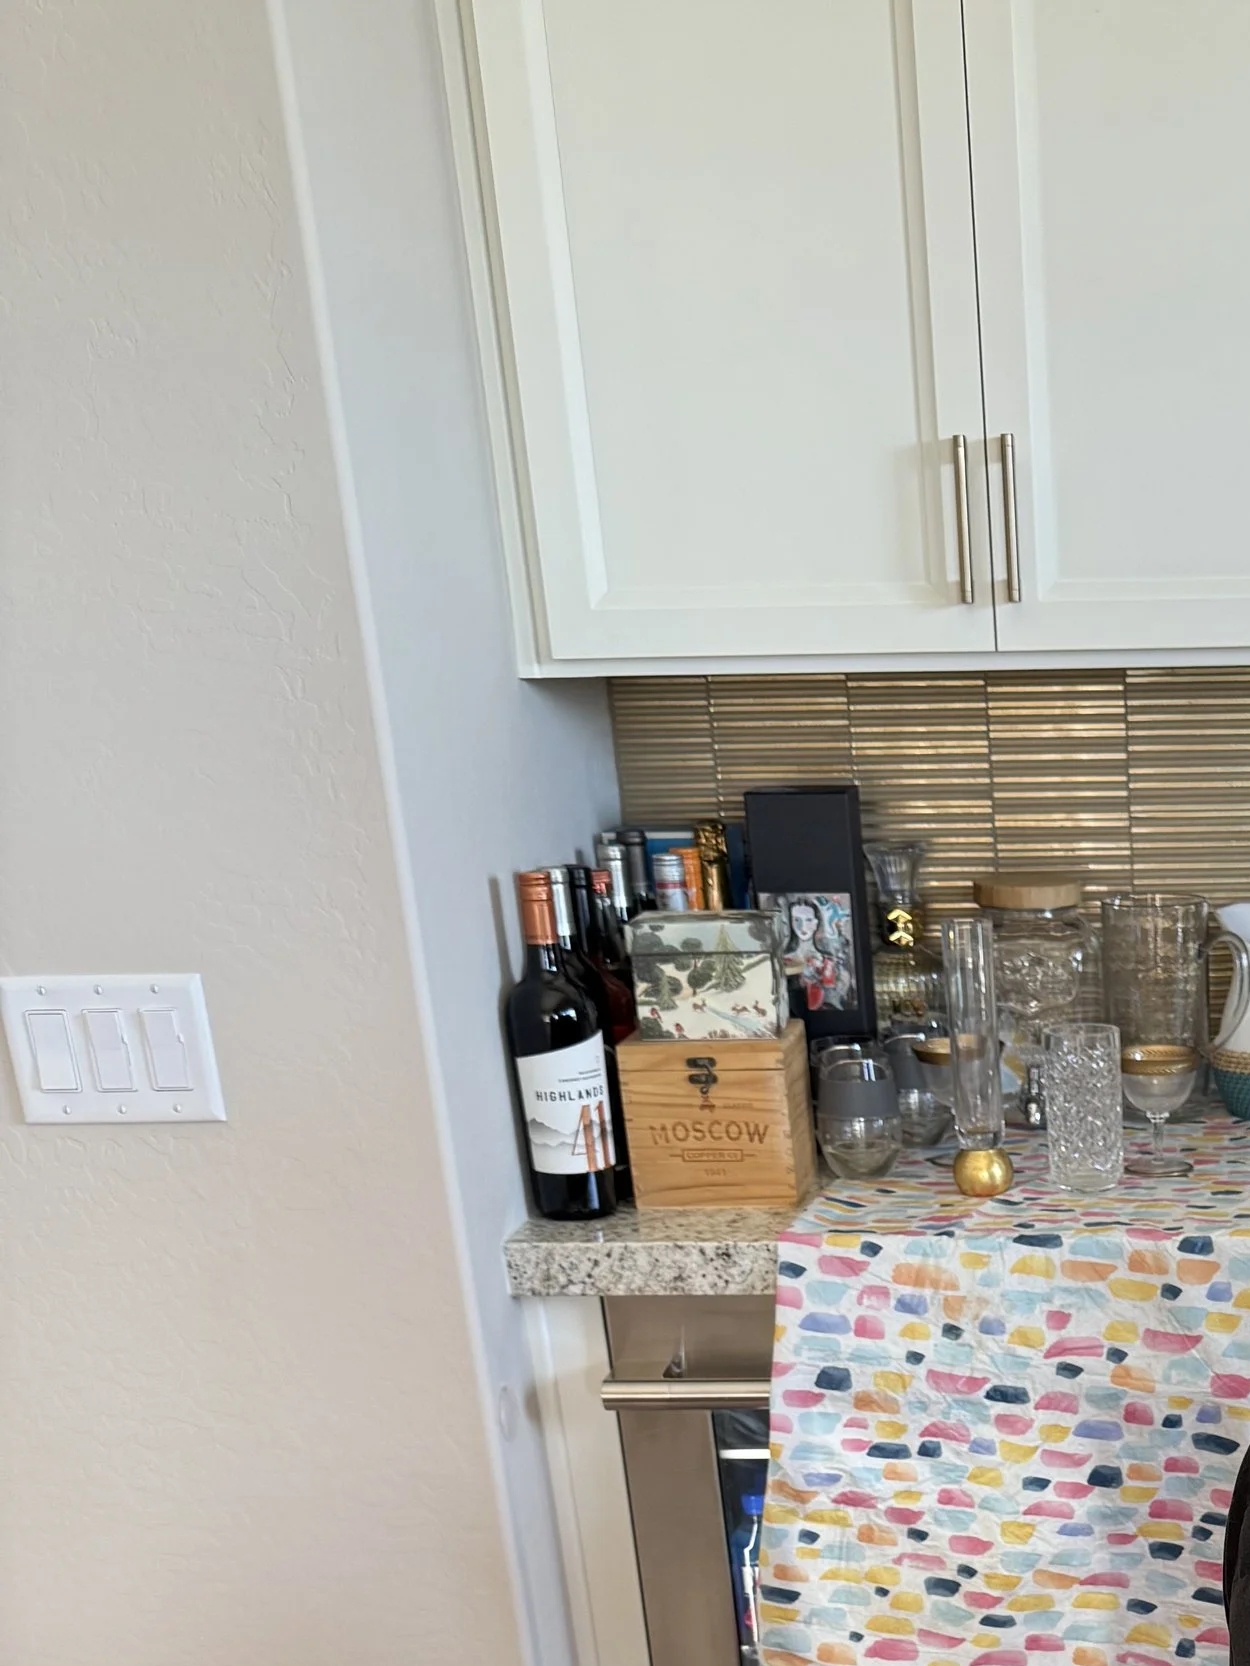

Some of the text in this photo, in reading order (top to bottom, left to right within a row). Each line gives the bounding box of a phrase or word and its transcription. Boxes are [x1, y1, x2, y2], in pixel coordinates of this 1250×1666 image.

[535, 1085, 604, 1102] HIGHLANDS
[571, 1100, 611, 1173] 41
[649, 1119, 769, 1146] MOSCOW
